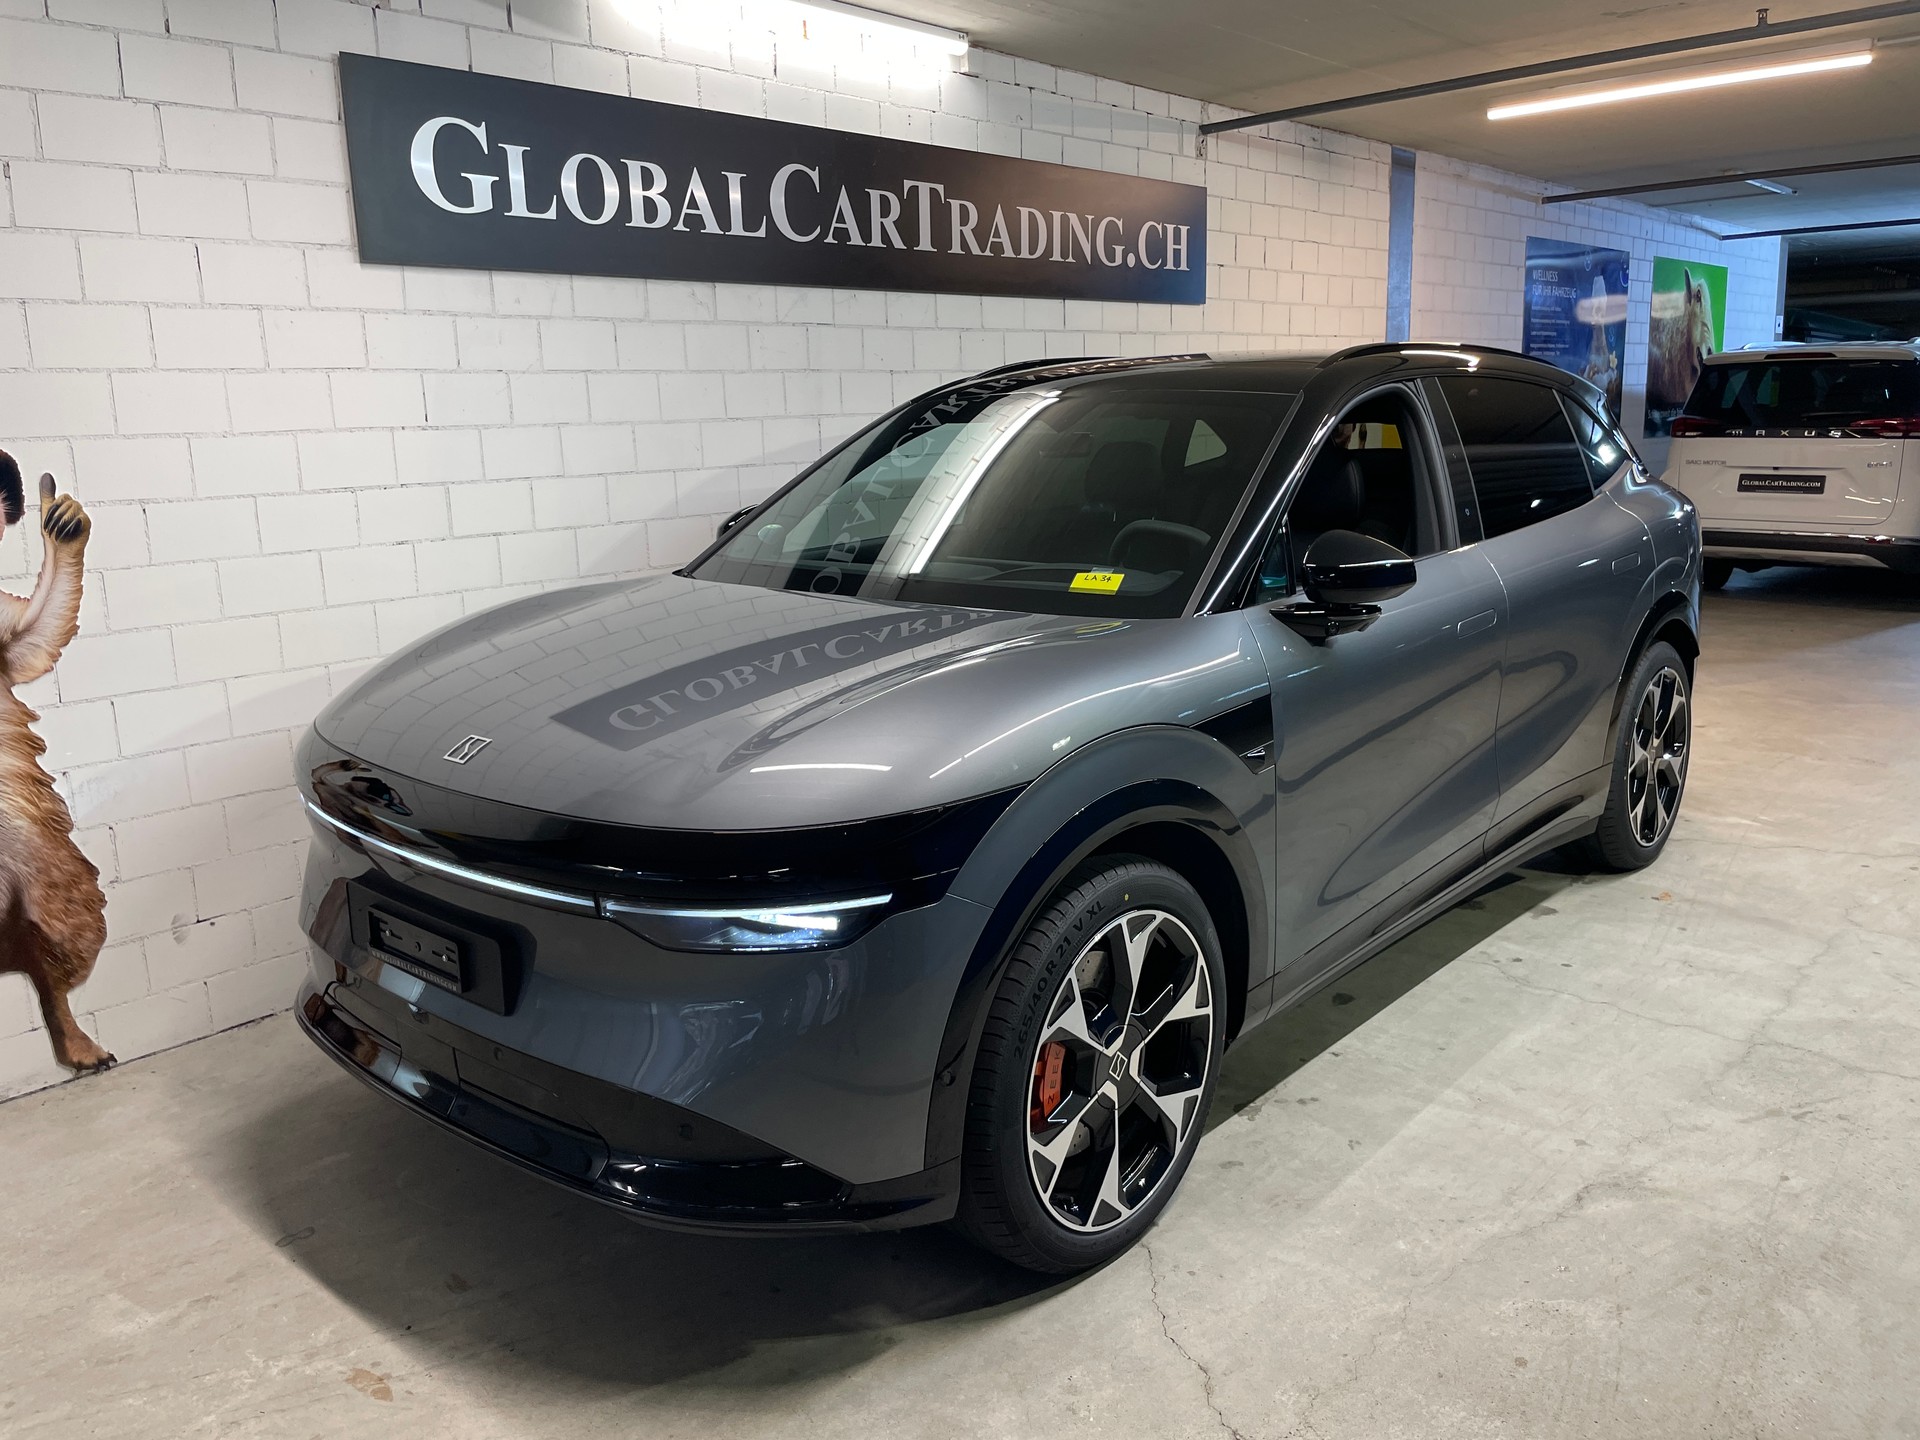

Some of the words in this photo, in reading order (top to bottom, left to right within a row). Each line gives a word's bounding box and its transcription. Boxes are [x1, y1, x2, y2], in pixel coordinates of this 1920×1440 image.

[410, 116, 1190, 272] GLOBALCARTRADING.CH
[1532, 269, 1559, 282] WELLNESS
[1742, 479, 1821, 488] GLOBALCARTRADING.COM
[1100, 574, 1112, 583] 34
[1014, 975, 1049, 1060] 265/40
[1045, 960, 1058, 976] R
[1056, 935, 1072, 959] 21
[1072, 917, 1084, 932] V
[1086, 900, 1107, 920] XL
